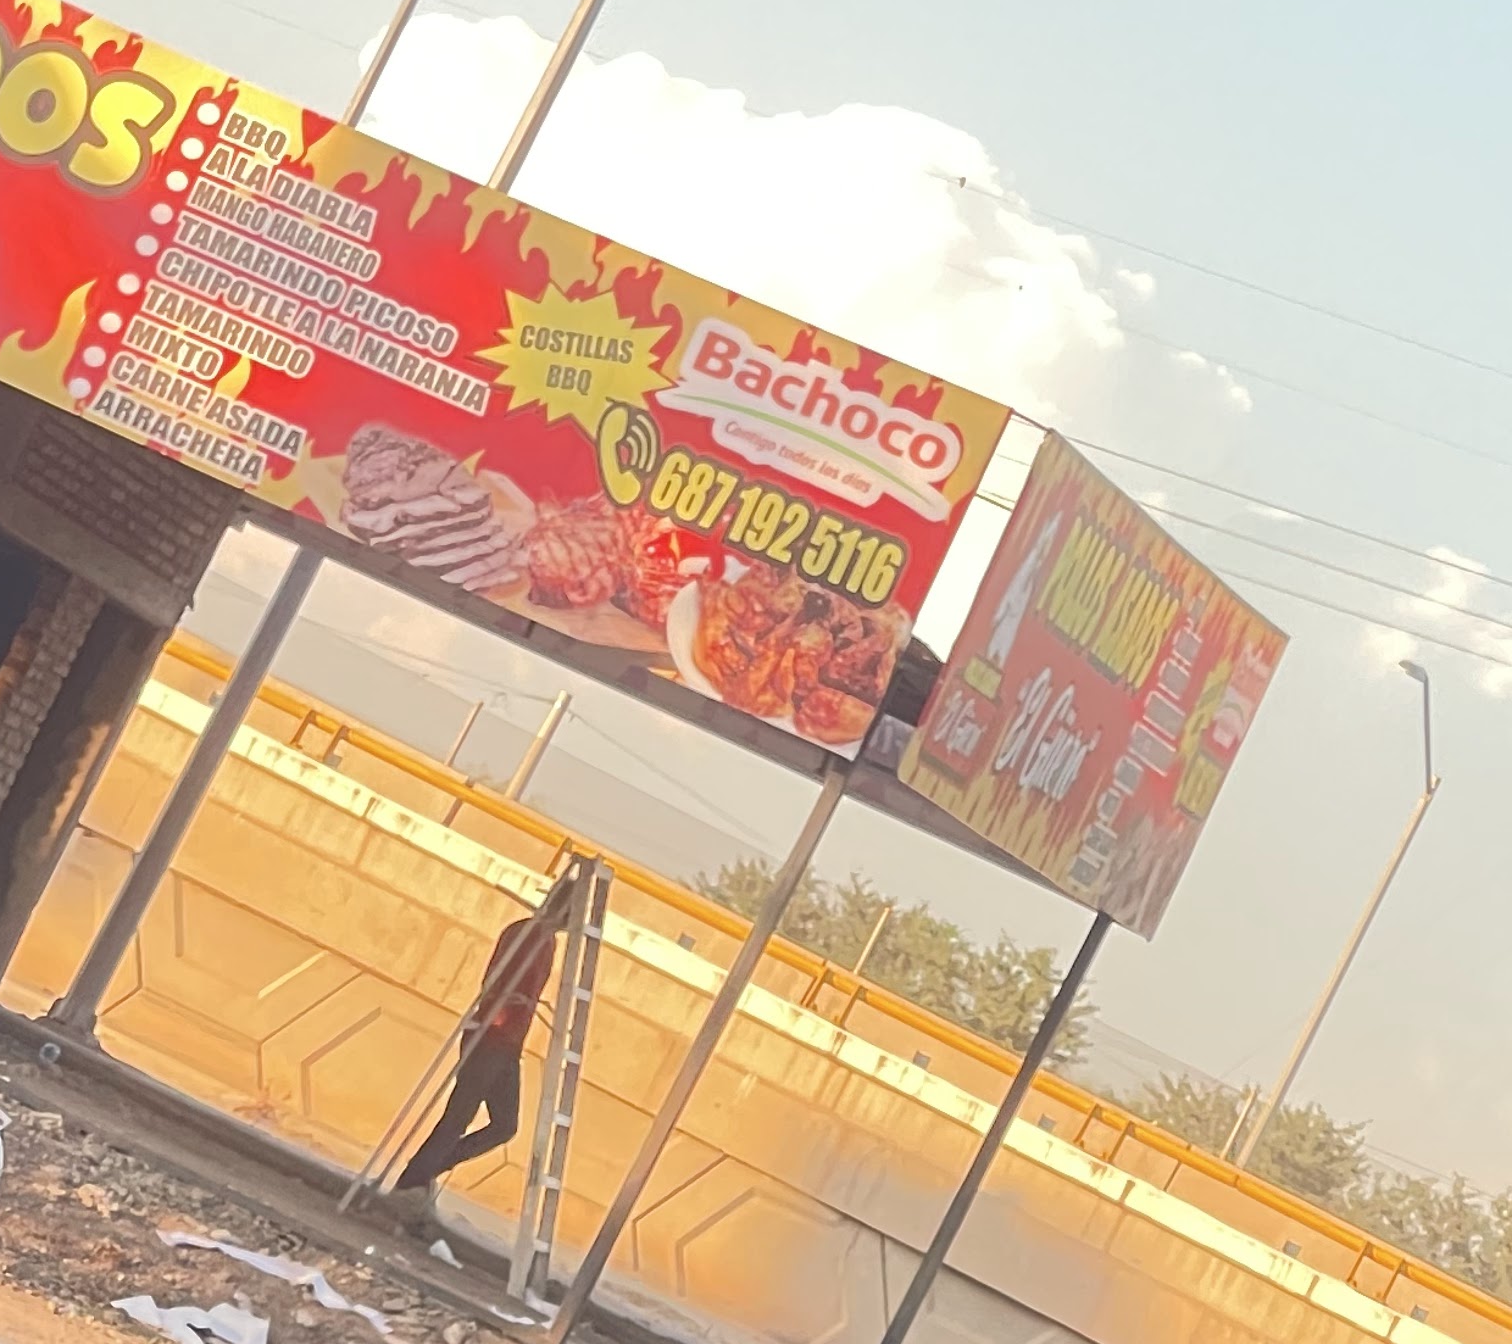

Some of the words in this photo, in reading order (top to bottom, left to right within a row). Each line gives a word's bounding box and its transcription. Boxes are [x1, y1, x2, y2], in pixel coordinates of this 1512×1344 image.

[223, 112, 287, 159] BBQ
[190, 180, 267, 231] MANGO
[266, 209, 379, 279] HABANERO
[205, 146, 229, 175] A
[232, 154, 265, 191] LA
[269, 171, 375, 239] DIABLA
[143, 282, 313, 376] TAMARINDO
[176, 213, 343, 306] TAMARINDO
[347, 289, 456, 354] PICOSO
[125, 319, 220, 377] MIXTO
[160, 252, 293, 327] CHIPOTLE
[296, 307, 319, 337] A
[321, 319, 354, 356] LA
[356, 337, 489, 414] NARANJA
[520, 324, 634, 364] COSTILLAS
[546, 364, 591, 395] BBQ
[92, 389, 265, 482] ARRACHERA
[110, 353, 214, 409] CARNE
[208, 394, 305, 457] ASADA
[693, 331, 948, 470] Bachoco
[650, 452, 738, 529] 687
[728, 485, 809, 563] 192
[802, 515, 906, 603] 5116
[1037, 515, 1126, 646] POLLOS
[1091, 564, 1181, 691] ASADOS
